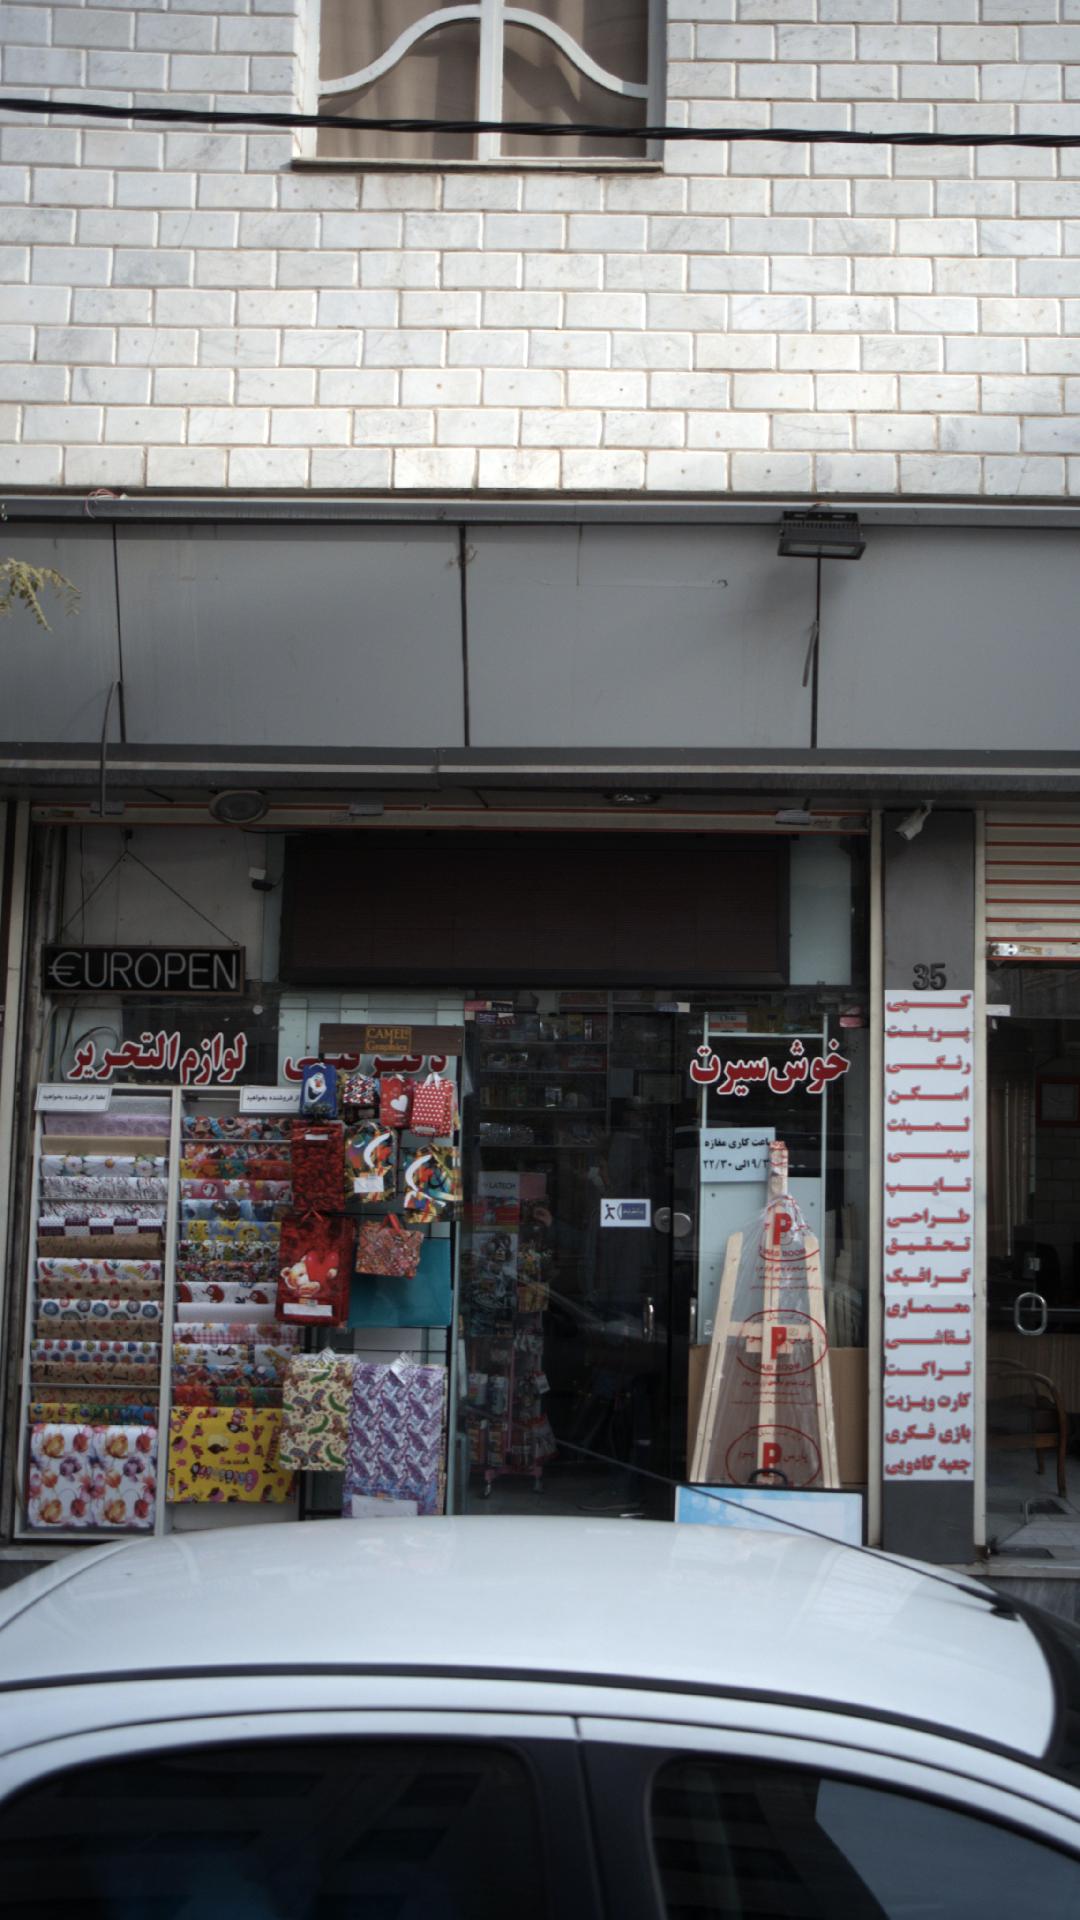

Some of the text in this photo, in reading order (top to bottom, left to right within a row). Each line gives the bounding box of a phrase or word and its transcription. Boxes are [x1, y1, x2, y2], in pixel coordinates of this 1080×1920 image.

[912, 963, 947, 990] 35
[886, 994, 971, 1013] کپی
[886, 1025, 971, 1043] پرینت
[67, 1030, 248, 1085] لوازم التحریر
[690, 1038, 851, 1096] خوش سیرت
[886, 1055, 972, 1074] رنگی
[887, 1086, 969, 1105] اسکن
[887, 1117, 970, 1135] لمینت
[704, 1137, 770, 1149] اعت کاری مغازه
[886, 1177, 972, 1198] تایپ
[886, 1208, 970, 1228] طراحی
[886, 1236, 971, 1255] تحقیق
[886, 1267, 970, 1287] گرافیک
[886, 1298, 971, 1318] معماری
[884, 1329, 971, 1349] نقاشی
[885, 1360, 971, 1381] تراکت
[885, 1391, 971, 1412] کارت ویزیت
[885, 1422, 971, 1444] بازی فکری
[938, 1457, 971, 1475] جعبه
